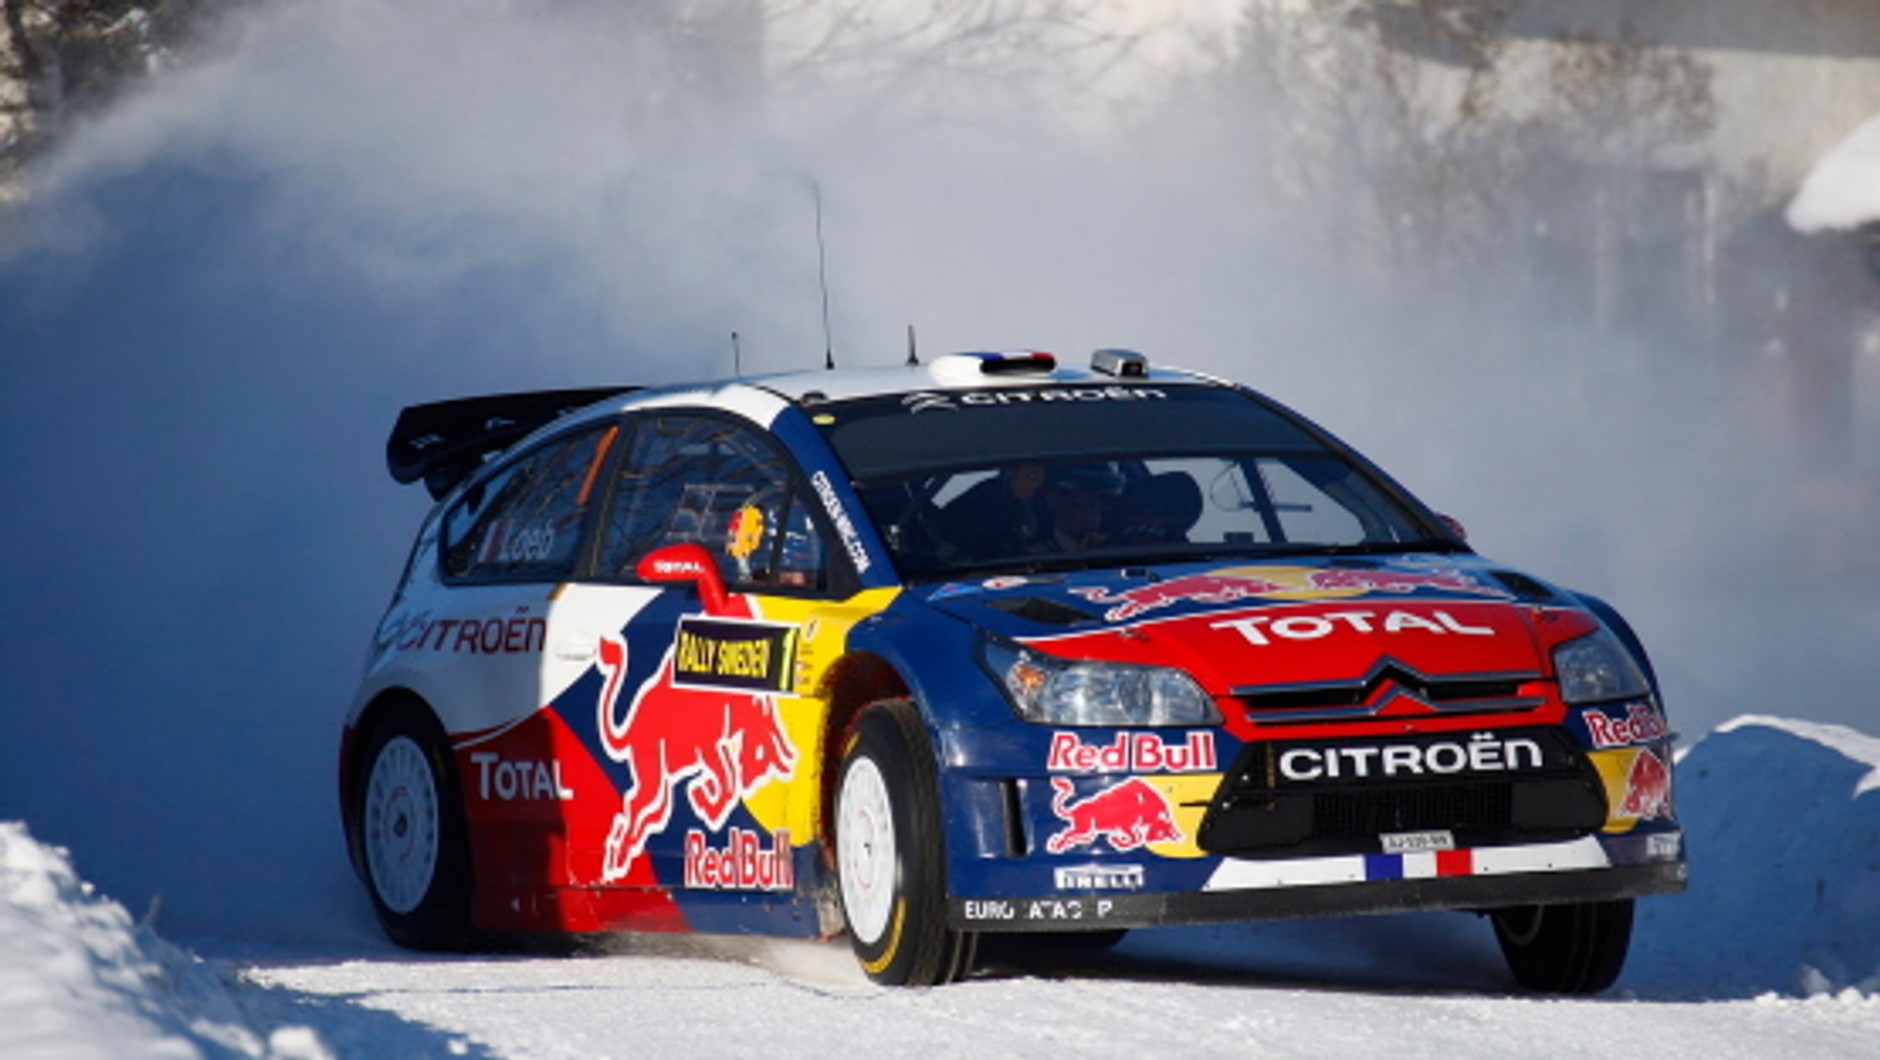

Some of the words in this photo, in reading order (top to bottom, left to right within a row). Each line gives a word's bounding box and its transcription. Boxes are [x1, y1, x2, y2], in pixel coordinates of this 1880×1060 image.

[1209, 611, 1495, 645] TOTAL
[677, 631, 717, 672] RALLY
[717, 637, 773, 679] SWEDEN
[779, 628, 797, 691] 1
[470, 752, 574, 800] TOTAL
[1279, 732, 1543, 781] CITROËN
